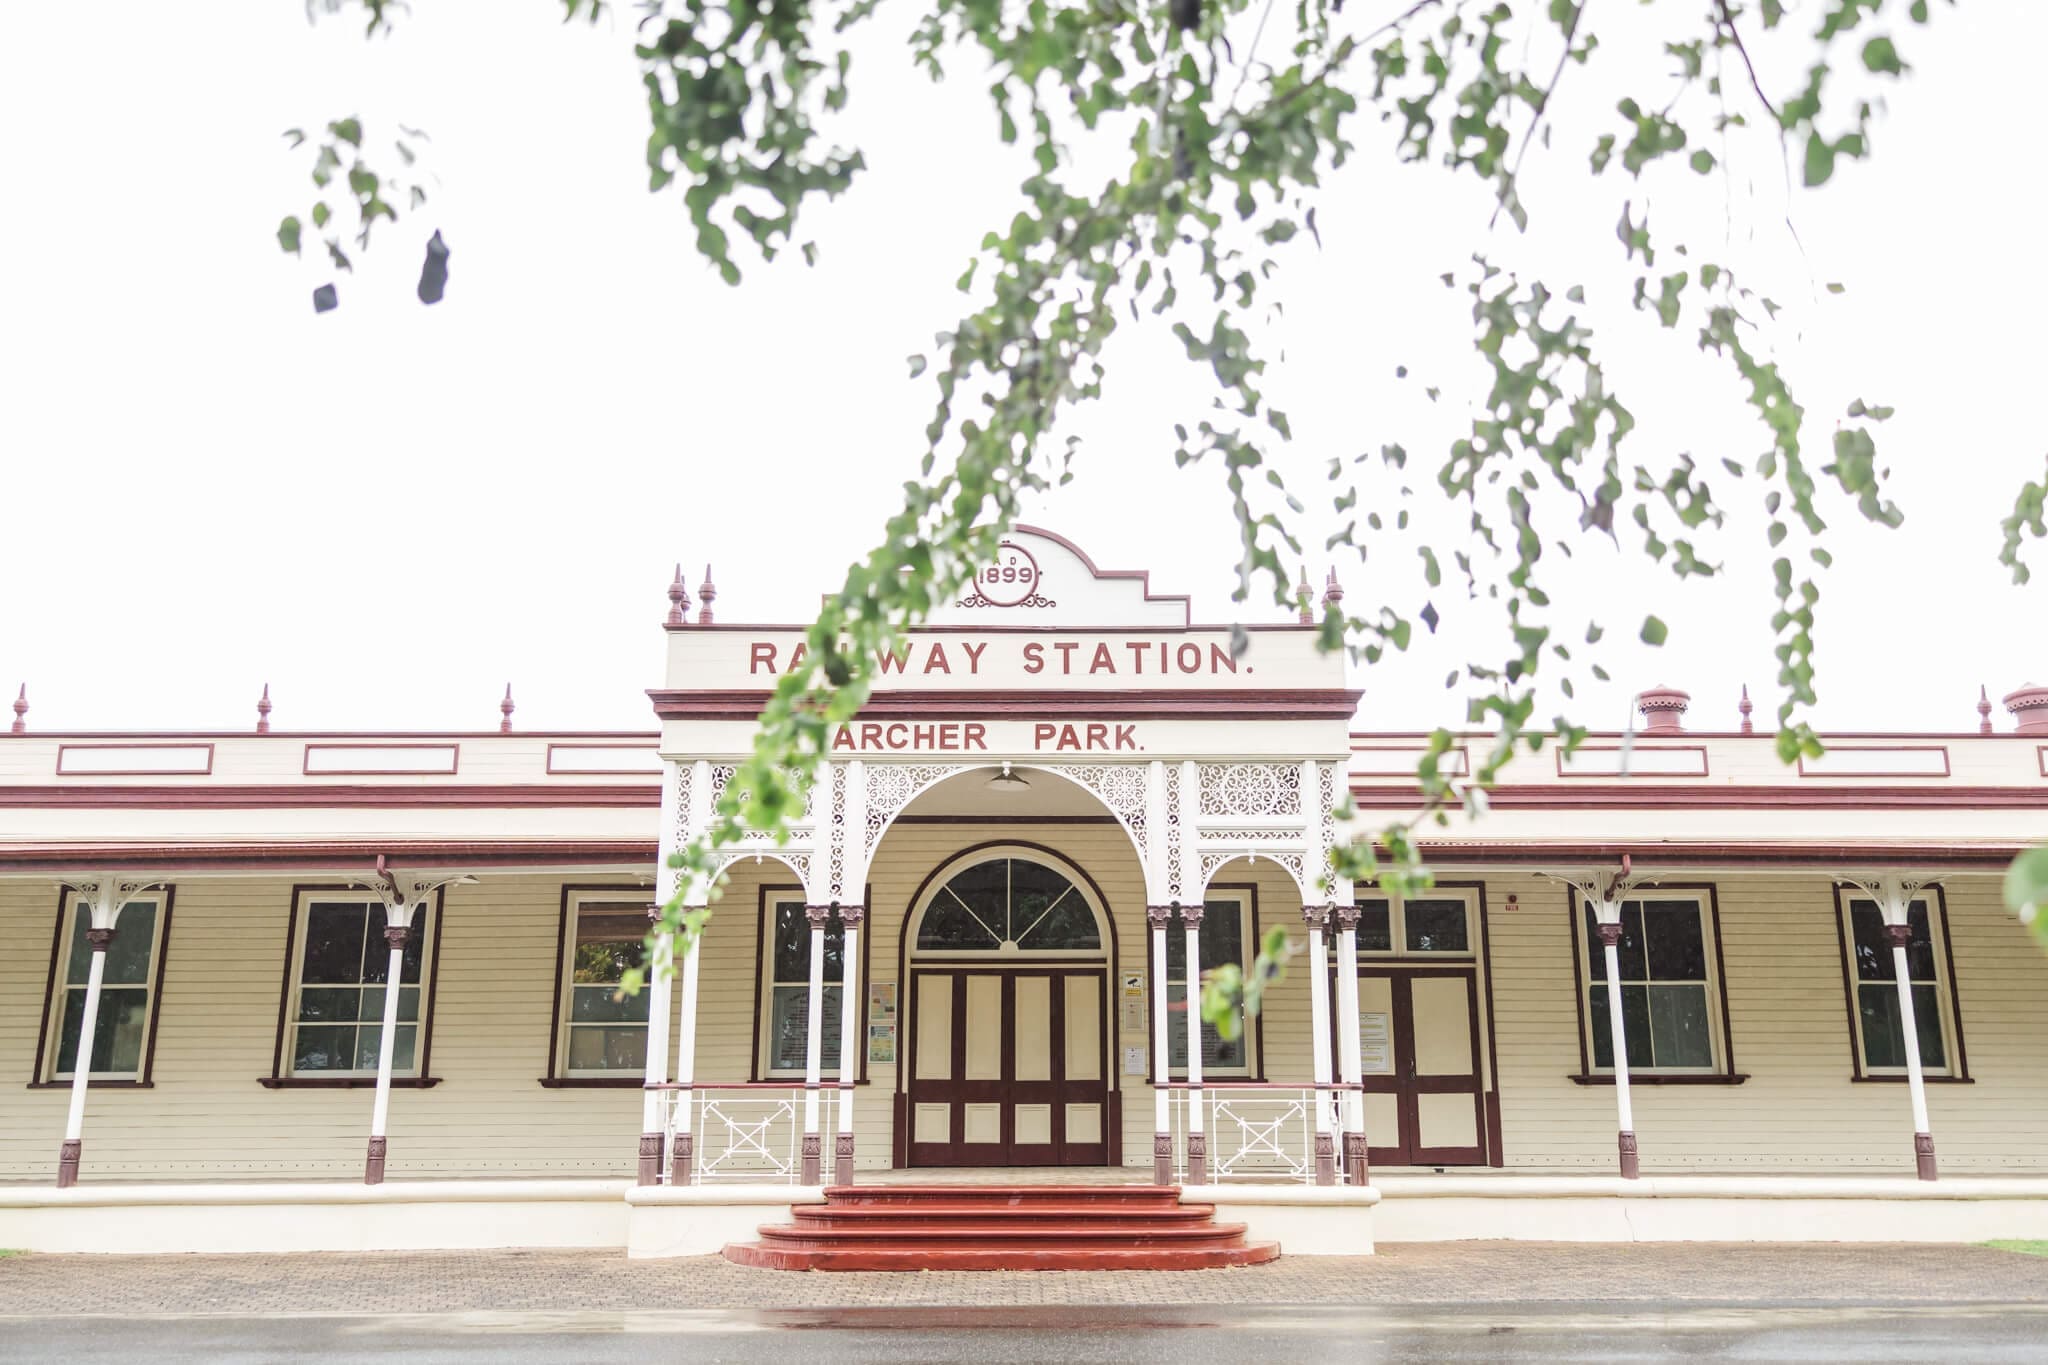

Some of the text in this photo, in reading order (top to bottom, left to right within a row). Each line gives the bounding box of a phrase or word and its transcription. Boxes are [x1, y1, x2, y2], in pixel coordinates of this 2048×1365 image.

[1010, 556, 1017, 566] D
[980, 568, 1033, 584] 1899
[750, 642, 1253, 675] RAWAY STATION.
[832, 723, 1145, 751] ARCHER PARK.
